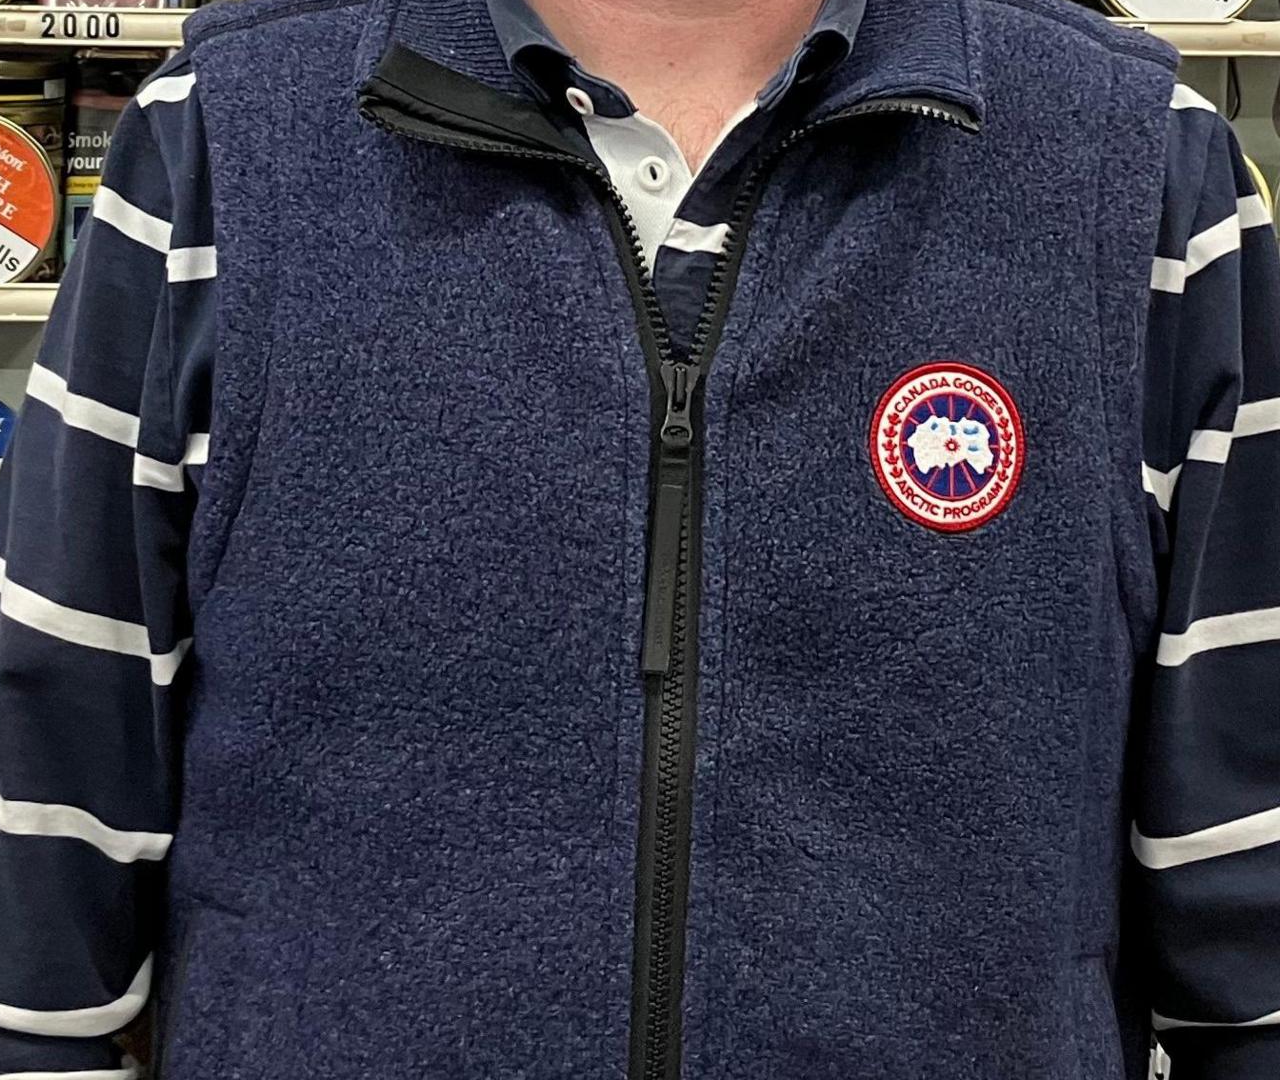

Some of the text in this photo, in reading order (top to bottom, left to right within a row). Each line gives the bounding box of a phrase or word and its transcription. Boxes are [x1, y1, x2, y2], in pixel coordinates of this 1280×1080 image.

[895, 377, 998, 413] CANADA GOOSE
[896, 479, 1004, 519] ARCTIC PROGRAM
